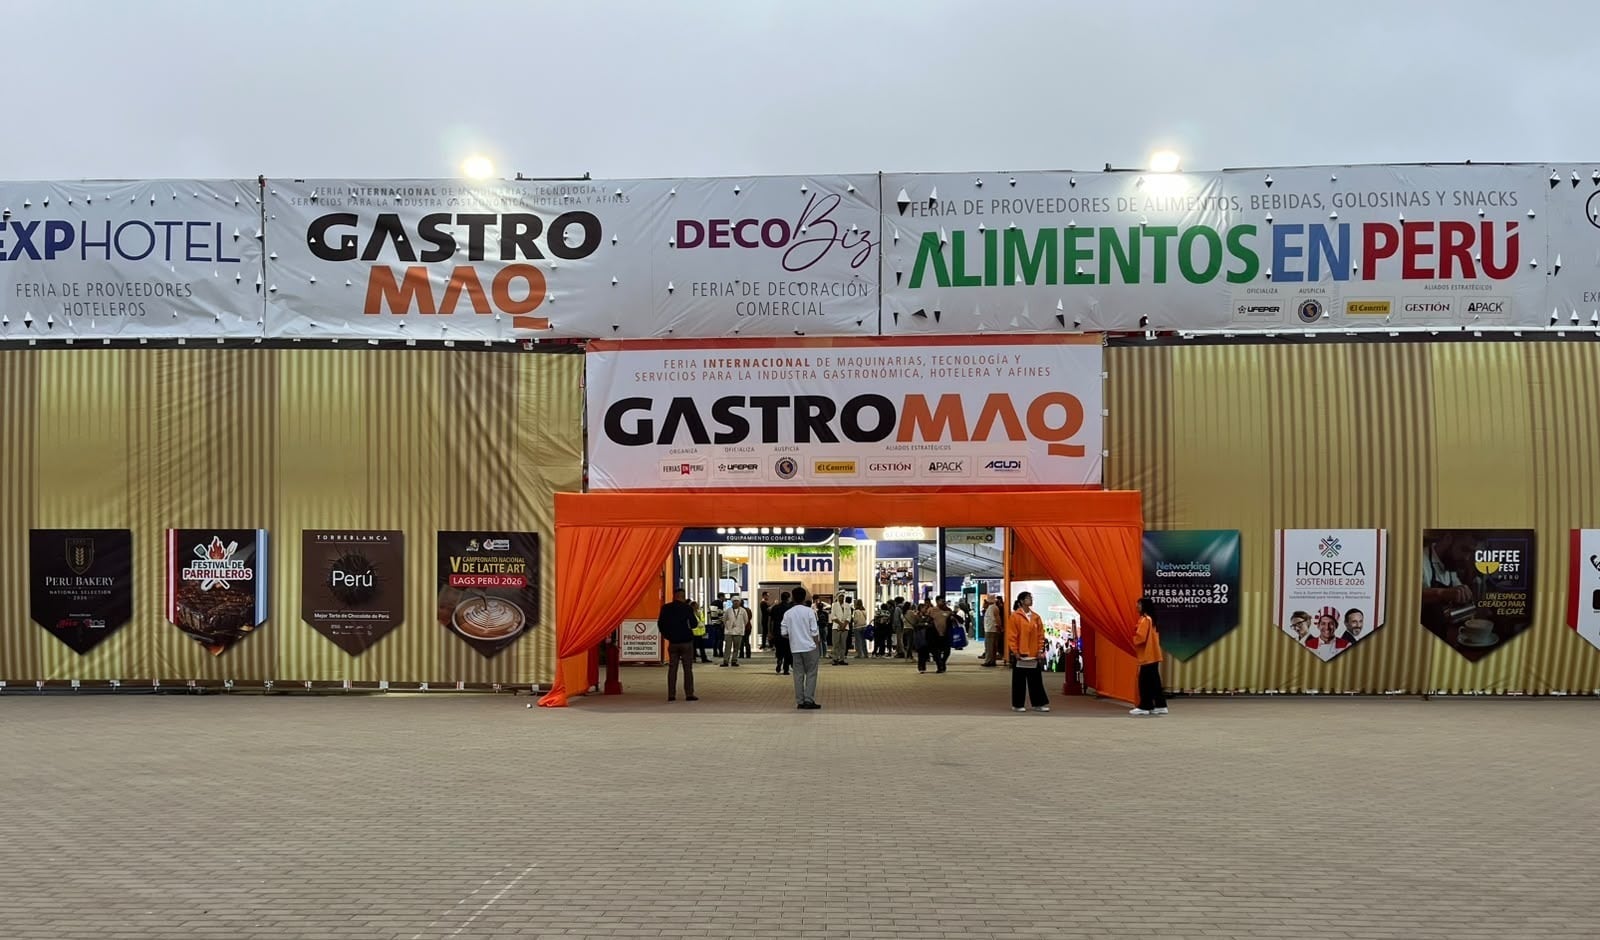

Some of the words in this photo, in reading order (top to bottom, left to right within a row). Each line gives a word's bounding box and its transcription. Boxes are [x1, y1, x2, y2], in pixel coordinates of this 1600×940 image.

[348, 187, 438, 196] INTERNACIONAL
[442, 188, 452, 196] DE
[536, 185, 597, 196] TECNOLOGÍA
[290, 198, 342, 206] SERVICIOS
[347, 198, 372, 206] PARA
[376, 198, 388, 206] LA
[534, 196, 582, 206] HOTELERA
[596, 196, 631, 204] AFINES
[910, 199, 955, 218] FERIA
[964, 200, 984, 216] DE
[991, 197, 1110, 214] PROVEEDORES
[1117, 197, 1138, 212] DE
[1144, 195, 1243, 212] ALIMENTOS,
[1250, 193, 1326, 211] BEBIDAS,
[1332, 192, 1430, 208] GOLOSINAS
[1436, 192, 1445, 206] Y
[1452, 190, 1518, 207] SNACKS
[306, 210, 603, 263] GASTRO
[908, 224, 1260, 288] ALIMENTOS
[1272, 223, 1350, 282] EN
[1362, 220, 1520, 280] PERÚ
[16, 282, 56, 297] FERIA
[63, 282, 80, 297] DE
[86, 282, 192, 298] PROVEEDORES
[692, 282, 735, 297] FERIA
[742, 282, 760, 296] DE
[768, 280, 869, 297] DECORACIÓN
[363, 262, 550, 329] MAQ
[64, 302, 146, 317] HOTELEROS
[736, 301, 826, 316] COMERCIAL
[1404, 301, 1450, 312] GESTIÓN
[1468, 302, 1504, 312] APACK
[664, 360, 697, 369] FERIA
[704, 358, 810, 368] INTERNACIONAL
[816, 358, 830, 367] DE
[838, 356, 926, 368] MAQUINARIAS,
[932, 352, 1008, 366] TECNOLOGÍA
[1014, 354, 1022, 364] Y
[634, 371, 696, 382] SERVICIOS
[702, 370, 732, 381] PARA
[738, 370, 751, 380] LA
[758, 370, 817, 380] INDUSTRA
[824, 366, 924, 380] GASTRONÓMICA,
[930, 367, 990, 378] HOTELERA
[996, 367, 1002, 377] Y
[1008, 366, 1050, 377] AFINES
[604, 391, 1086, 457] GASTROMAQ
[662, 465, 680, 473] FERIAS
[869, 462, 912, 472] GESTIÓN
[928, 461, 962, 471] APACK
[1474, 550, 1520, 563] COFFEE
[450, 556, 461, 573] V
[782, 553, 833, 572] ilum
[1156, 561, 1211, 572] Networking
[1498, 564, 1520, 572] FEST
[183, 569, 252, 579] PARRILLEROS
[463, 564, 475, 573] DE
[478, 564, 505, 574] LATTE
[507, 564, 526, 574] ART
[1296, 561, 1366, 576] HORECA
[46, 576, 73, 586] PERU
[76, 576, 115, 586] BAKERY
[332, 570, 373, 587] Perú
[478, 576, 500, 585] PERÚ
[1296, 578, 1343, 586] SOSTENIBLE
[1345, 578, 1365, 586] 2026
[1213, 584, 1229, 594] 20
[1150, 596, 1213, 604] STRONÓMICOS
[1213, 594, 1229, 604] 26
